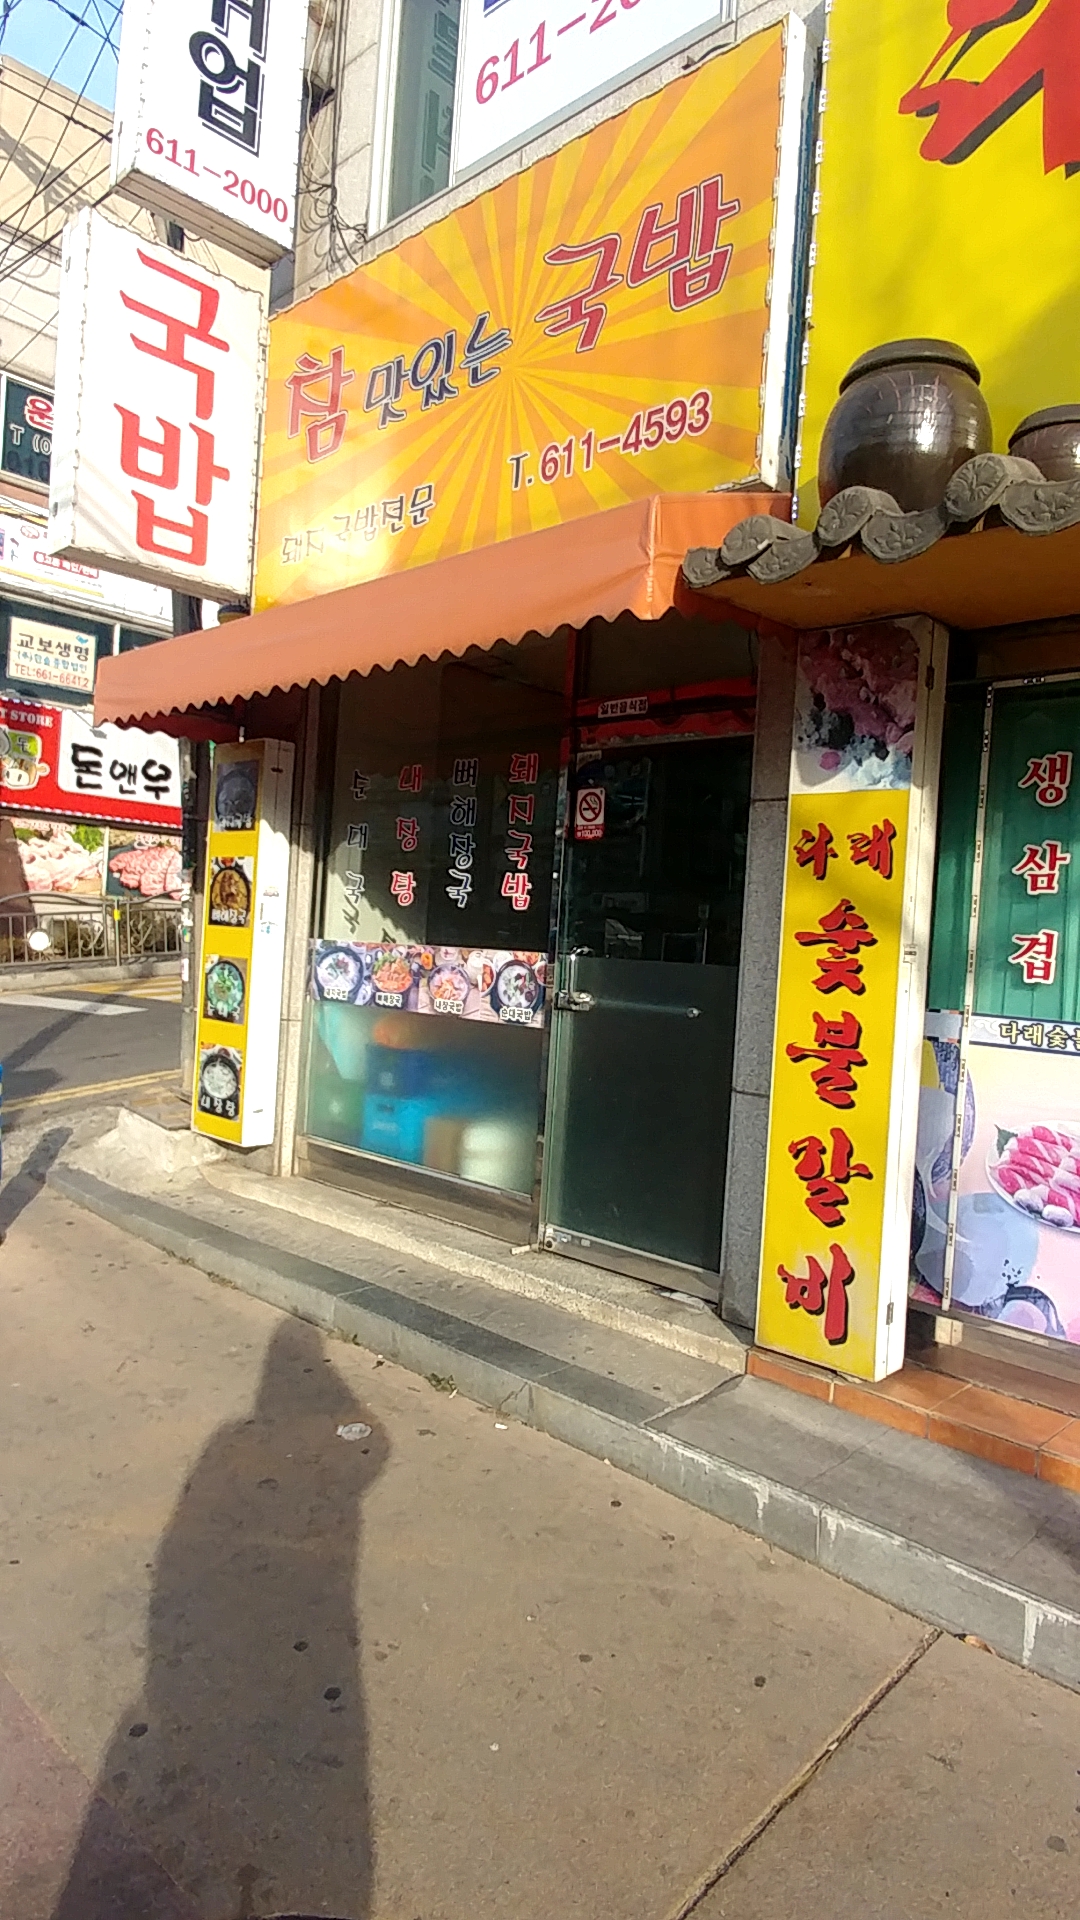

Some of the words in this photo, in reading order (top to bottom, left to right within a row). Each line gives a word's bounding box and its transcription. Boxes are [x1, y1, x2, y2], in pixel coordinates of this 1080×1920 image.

[146, 127, 289, 223] 611-2000
[535, 174, 740, 353] 국밥
[113, 247, 231, 566] 국밥
[17, 632, 90, 662] 교보생명
[10, 709, 53, 728] STORE
[71, 742, 172, 800] 돈앤우
[391, 765, 422, 906] 내장탕
[446, 758, 478, 908] 뼈해장국
[501, 753, 538, 910] 돼지국밥
[1008, 752, 1073, 985] 생삼겹
[500, 1007, 533, 1022] 순대국밥
